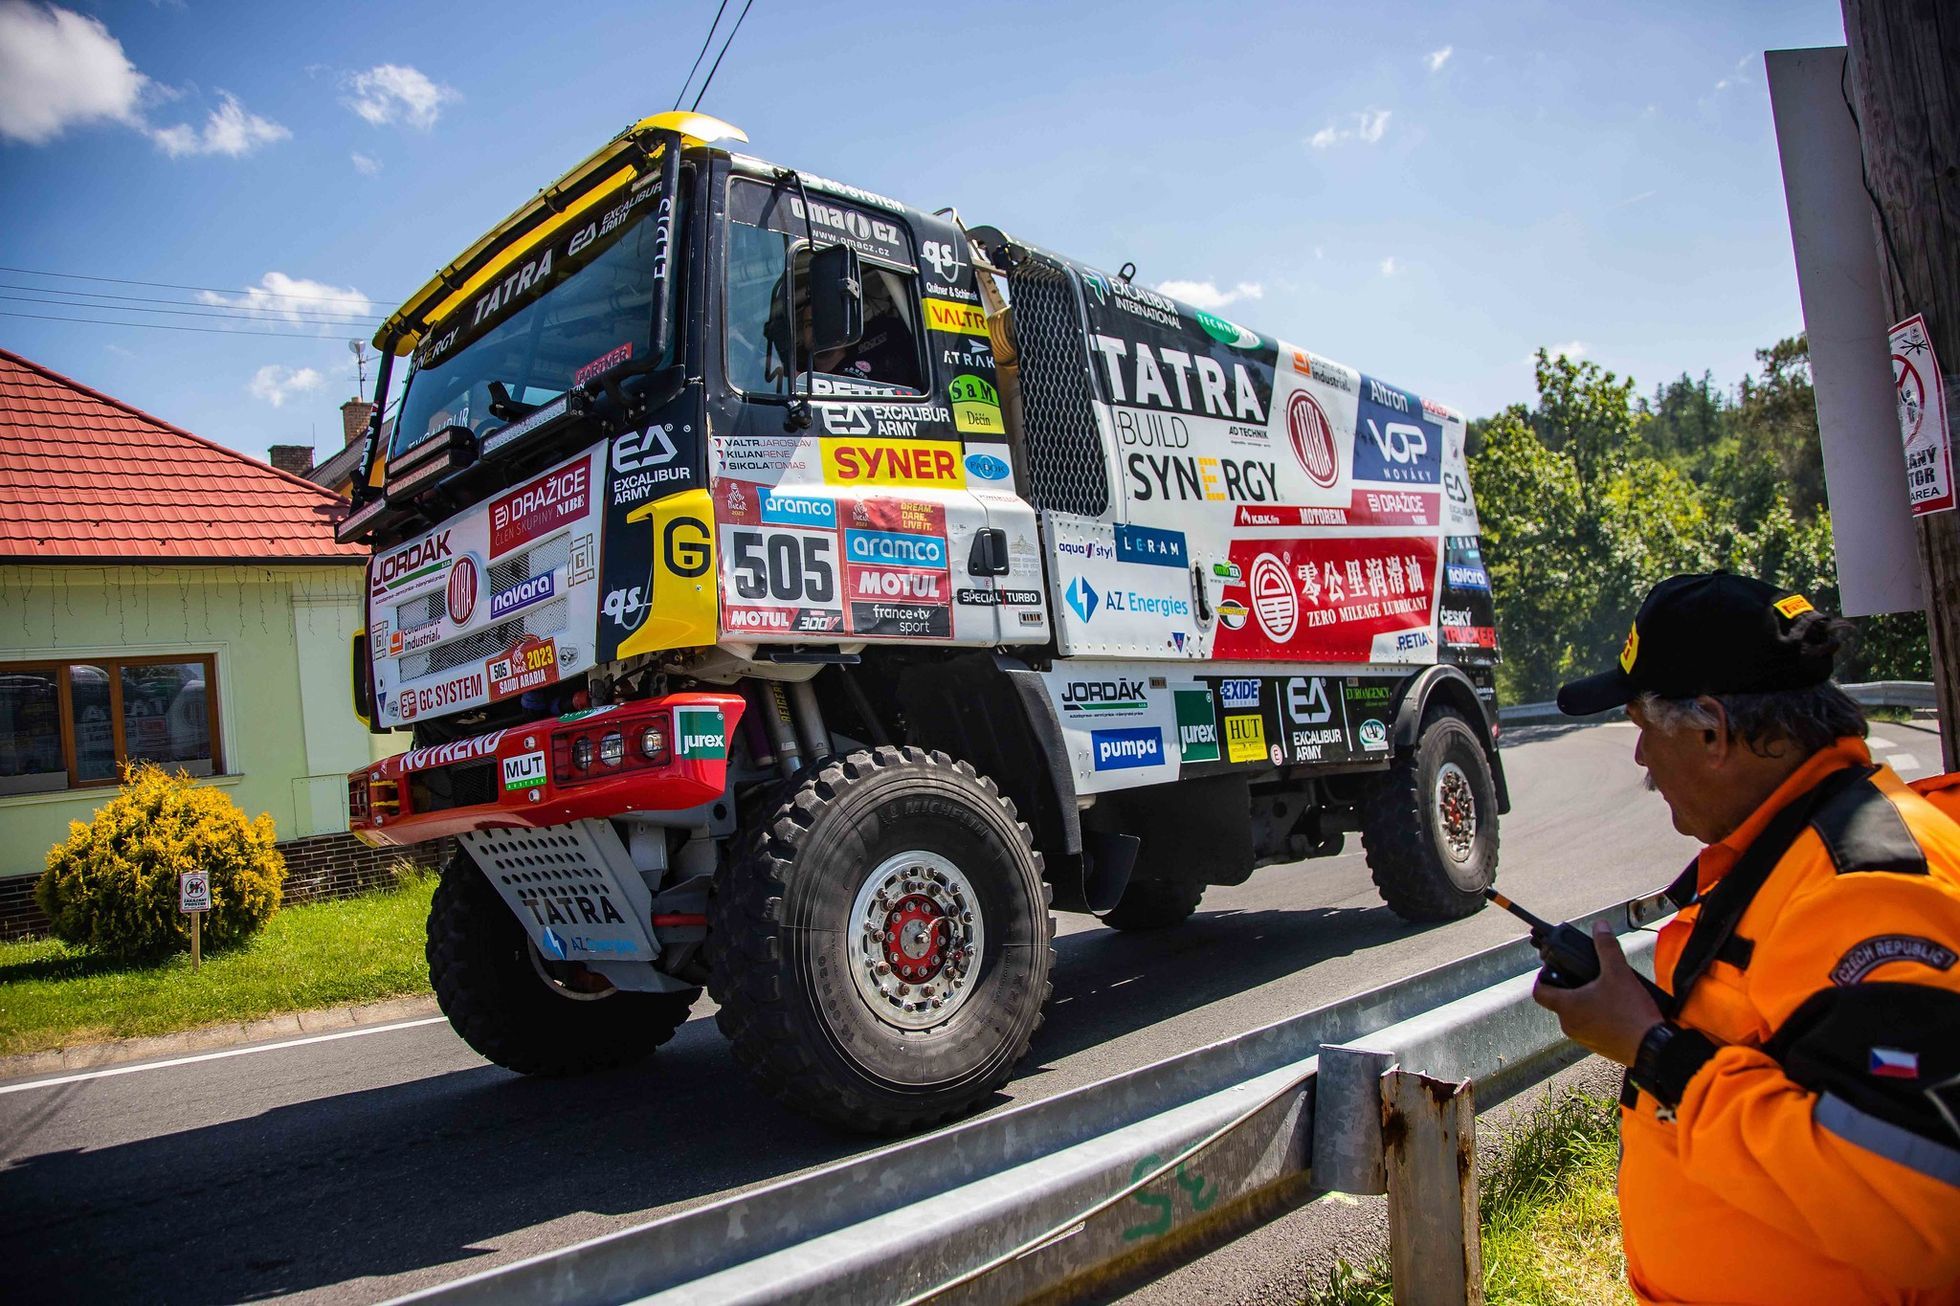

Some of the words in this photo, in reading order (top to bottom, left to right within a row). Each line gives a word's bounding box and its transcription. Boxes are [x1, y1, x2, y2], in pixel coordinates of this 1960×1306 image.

[598, 209, 631, 239] ARMY
[473, 248, 553, 327] TATRA
[1109, 277, 1179, 316] EXCALIBUR
[931, 305, 987, 330] VALTR
[1115, 296, 1182, 330] INTERNATIONAL
[1089, 333, 1269, 422] TATRA
[1370, 380, 1409, 413] Altron
[872, 405, 951, 423] EXCALIBUR
[877, 421, 919, 437] ARMY
[1118, 411, 1190, 449] BUILD
[1239, 427, 1269, 440] TECHNIK
[1366, 418, 1428, 465] VOP
[833, 446, 958, 480] SYNER
[1383, 467, 1432, 482] NOVÁKY
[613, 467, 691, 493] EXCALIBUR
[1128, 452, 1279, 502] SYNERGY
[511, 467, 587, 521] DRAŽICE
[556, 494, 585, 518] NIBE
[613, 485, 652, 506] ARMY
[765, 497, 832, 516] aramco
[1298, 508, 1348, 525] MOTORENA
[372, 529, 454, 588] JORDÁK
[853, 536, 940, 562] aramco
[1059, 542, 1085, 556] aqua
[1124, 536, 1179, 556] LERAM
[733, 531, 834, 603] 505
[858, 571, 940, 598] MOTUL
[1296, 555, 1426, 606] 零公里润滑油
[494, 575, 550, 613] navara
[962, 591, 1002, 604] SPECIAL
[1006, 592, 1037, 603] TURBO
[1106, 590, 1125, 610] AZ
[1128, 591, 1189, 617] Energies
[731, 610, 790, 627] MOTUL
[1307, 609, 1337, 629] ZERO
[1339, 602, 1382, 626] MILEAGE
[1382, 596, 1428, 617] LUBRICANT
[899, 622, 930, 635] sport
[1398, 631, 1429, 651] RETIA
[493, 662, 508, 680] 505
[527, 645, 554, 671] 2023
[418, 689, 435, 711] GC
[435, 673, 484, 706] SYSTEM
[499, 677, 520, 695] SAUDI
[520, 668, 547, 689] ARABIA
[1061, 677, 1148, 702] JORDÁK
[1222, 680, 1259, 700] EXIDE
[1180, 723, 1216, 754] jurex
[1230, 718, 1260, 740] HUT
[1292, 728, 1343, 746] EXCALIBUR
[683, 734, 725, 754] jurex
[1100, 739, 1158, 762] pumpa
[1296, 745, 1322, 761] ARMY
[505, 755, 543, 779] MUT
[522, 895, 626, 927] TATRA
[1837, 944, 1875, 982] CZECH
[1874, 940, 1945, 965] REPUBLIC
